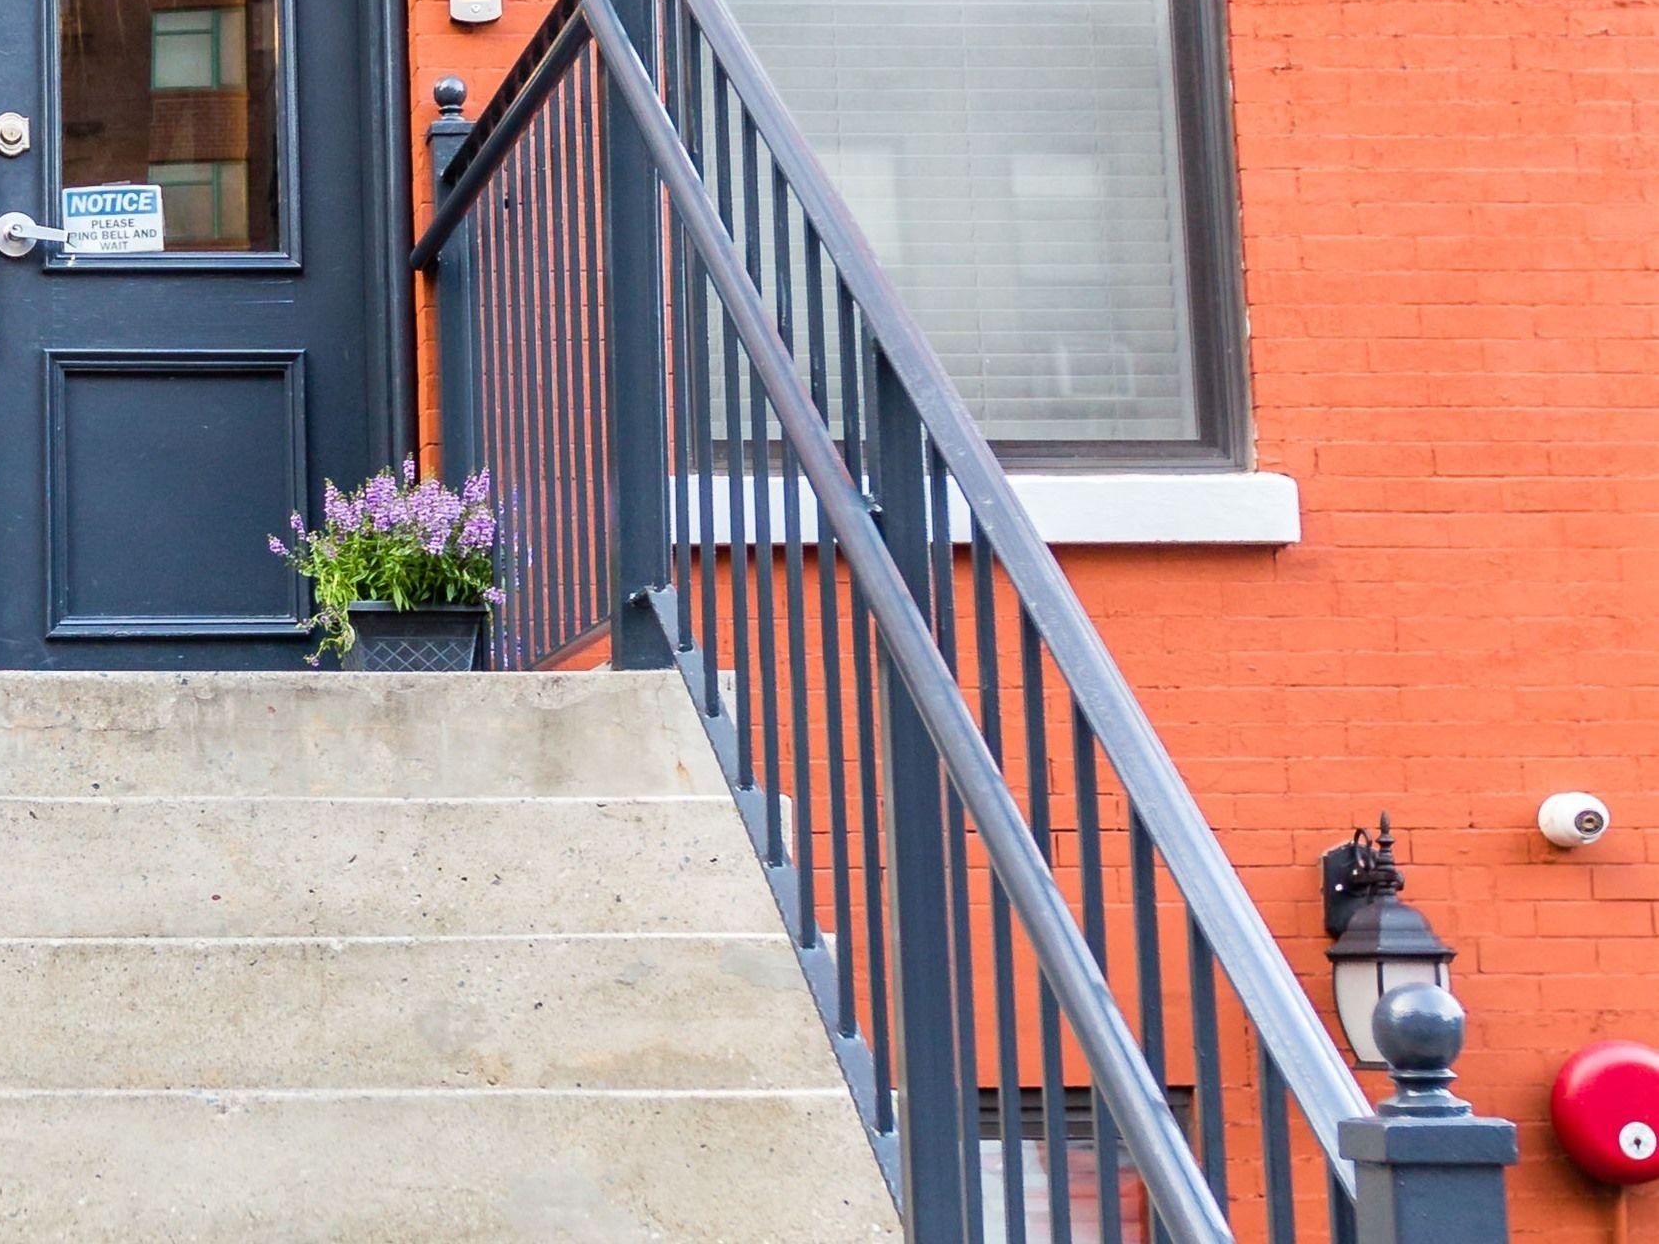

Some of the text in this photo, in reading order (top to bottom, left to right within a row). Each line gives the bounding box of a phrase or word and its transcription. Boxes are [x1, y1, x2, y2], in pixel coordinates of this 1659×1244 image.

[71, 192, 153, 213] NOTICE
[91, 218, 135, 229] PLEASE
[101, 230, 130, 240] BELL
[132, 228, 158, 239] AND
[100, 240, 129, 251] WAIT
